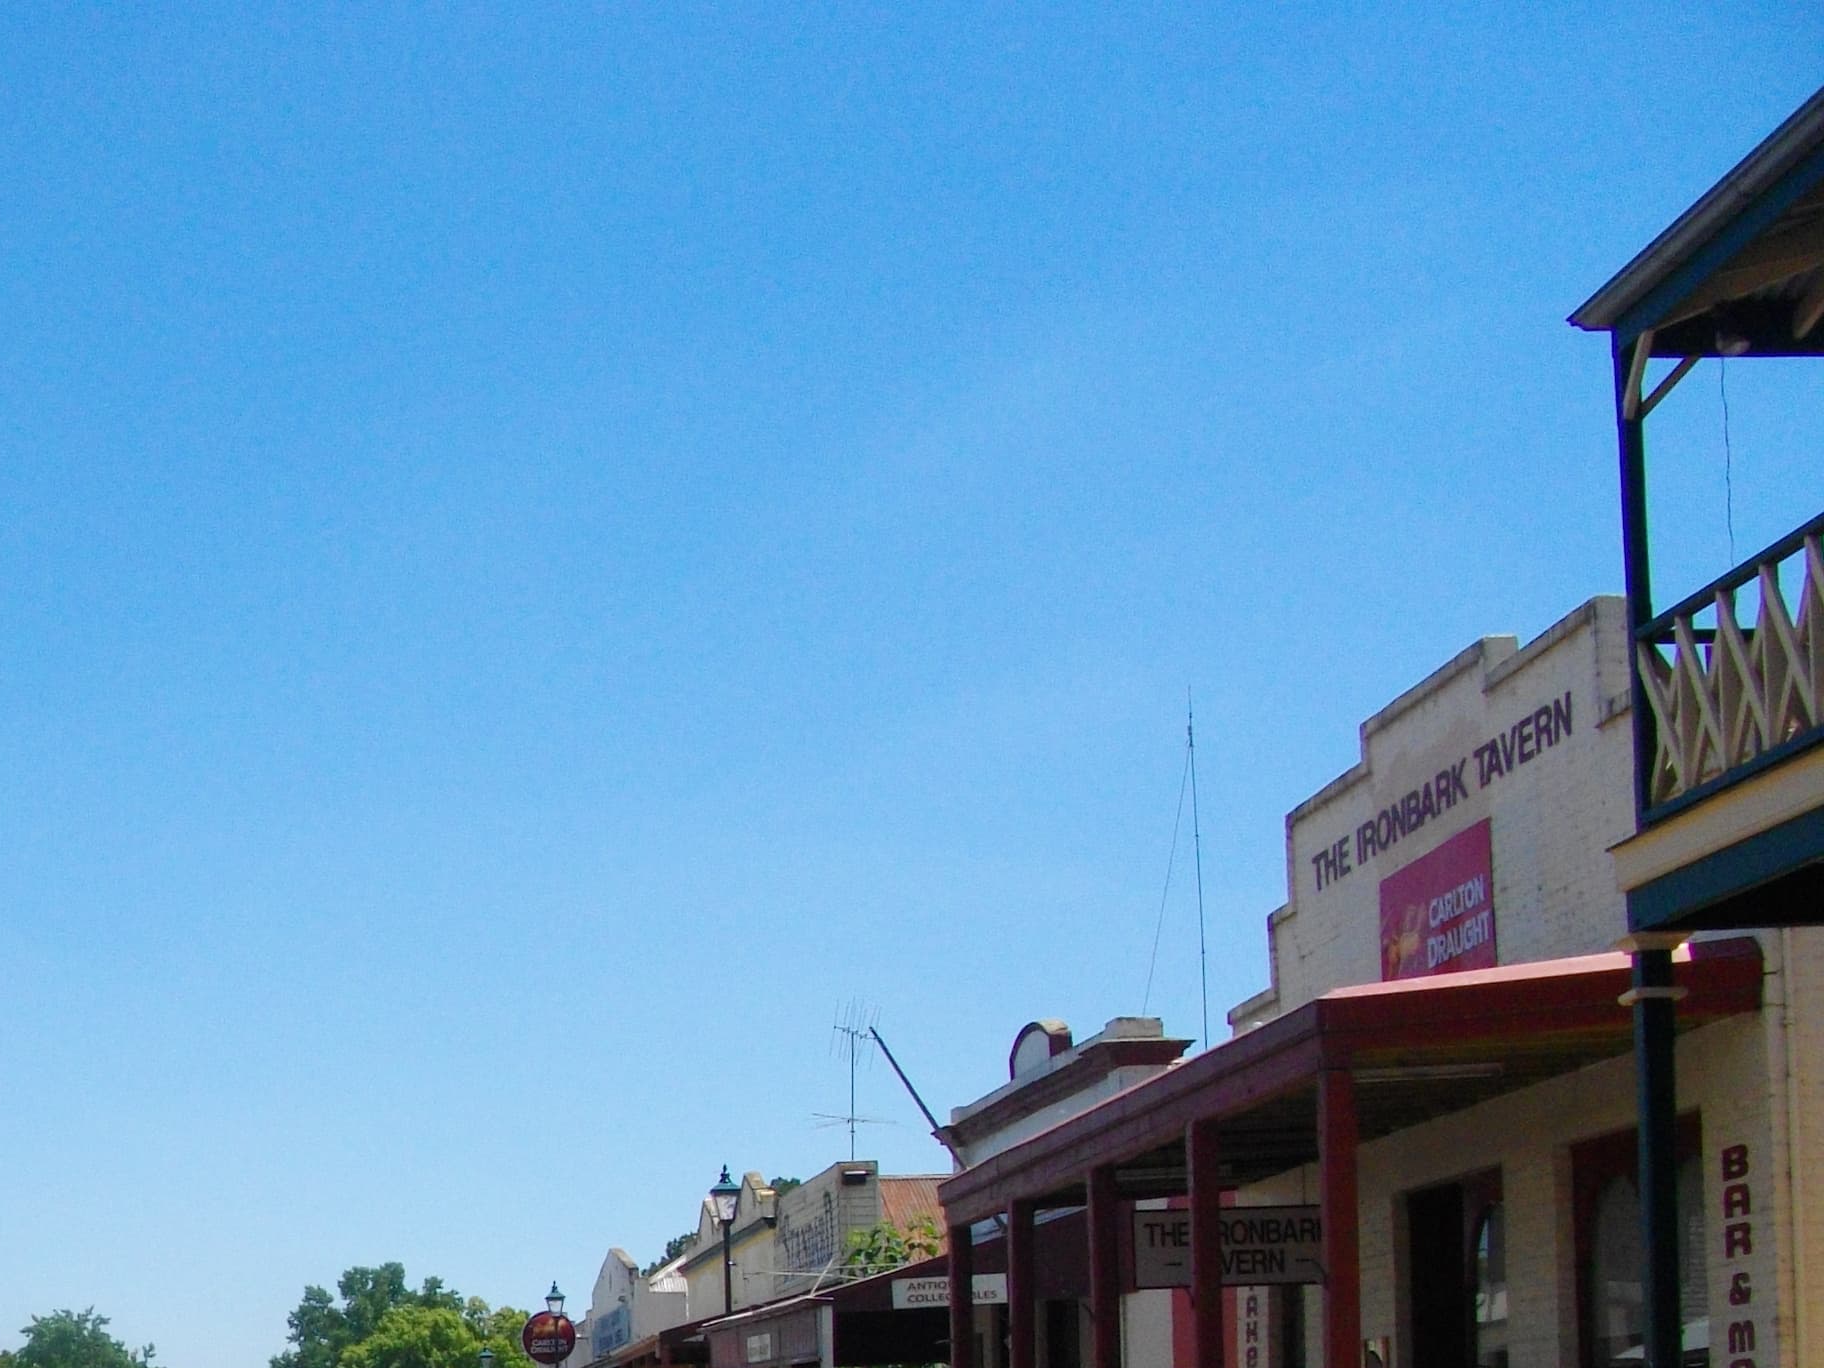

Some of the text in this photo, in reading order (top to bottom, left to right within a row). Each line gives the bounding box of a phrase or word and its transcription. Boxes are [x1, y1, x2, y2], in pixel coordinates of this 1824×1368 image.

[1312, 691, 1572, 892] THE IRONBARK TAVERN
[1429, 874, 1485, 929] CARLTON
[1427, 911, 1490, 969] DRAUGHT
[1721, 1144, 1753, 1258] BAR
[1143, 1217, 1322, 1247] THE RONBAR
[1220, 1249, 1285, 1275] VERN
[907, 1281, 954, 1292] ANTIQ
[907, 1290, 998, 1303] COLLECBLES
[1729, 1272, 1752, 1306] &
